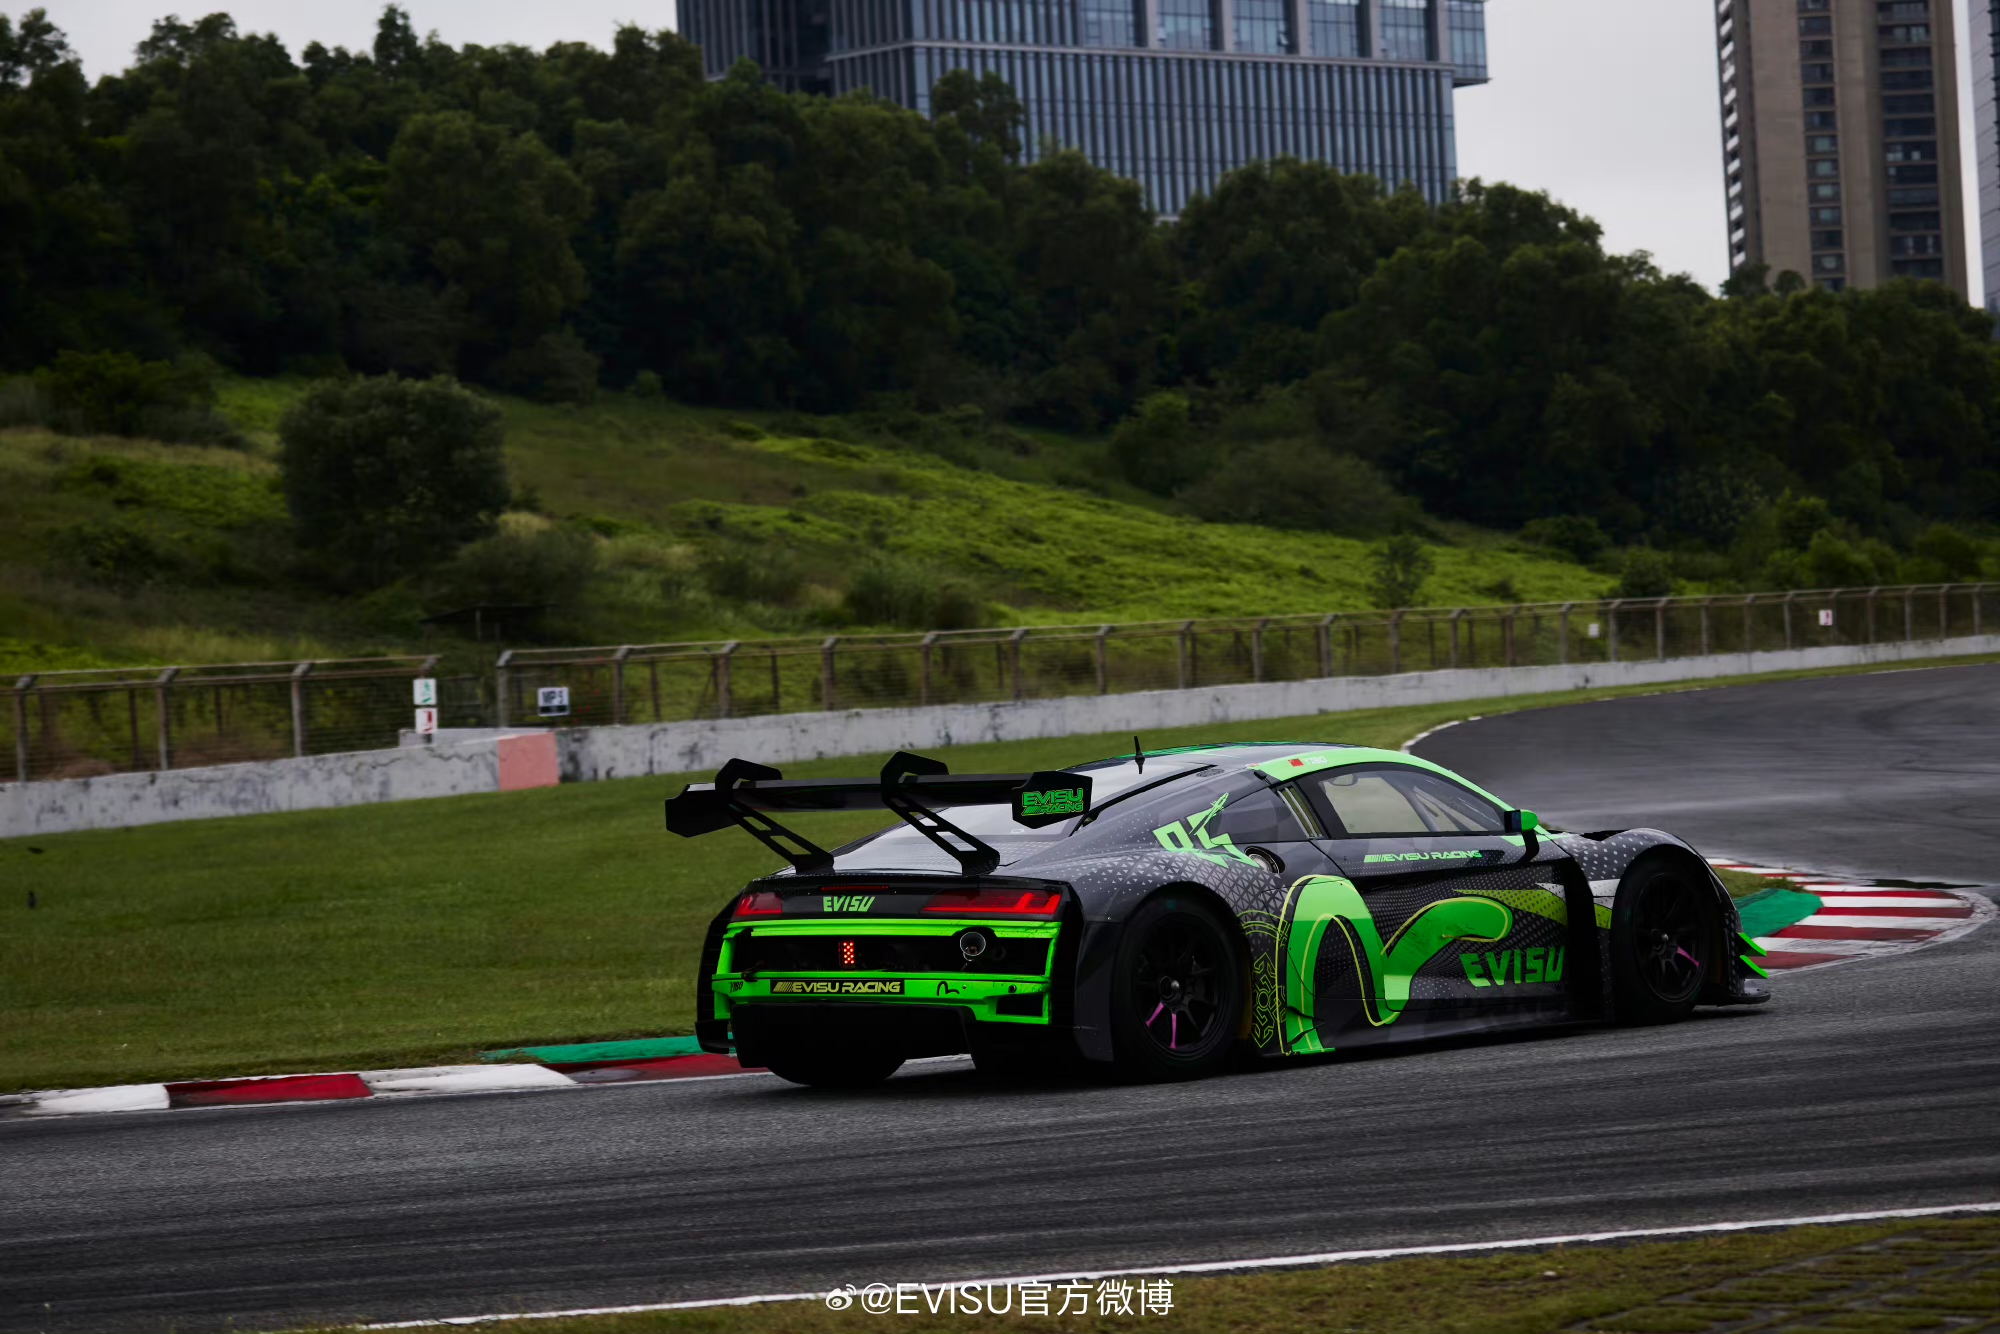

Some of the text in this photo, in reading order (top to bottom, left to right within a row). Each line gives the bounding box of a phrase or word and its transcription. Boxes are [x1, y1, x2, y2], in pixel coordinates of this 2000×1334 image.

[1022, 788, 1084, 806] EVISU
[1041, 802, 1083, 813] RACING
[1384, 850, 1483, 862] EVISU RACING
[823, 895, 876, 912] EVISU
[1459, 946, 1565, 987] EVISU
[793, 981, 902, 993] EVISU RACING
